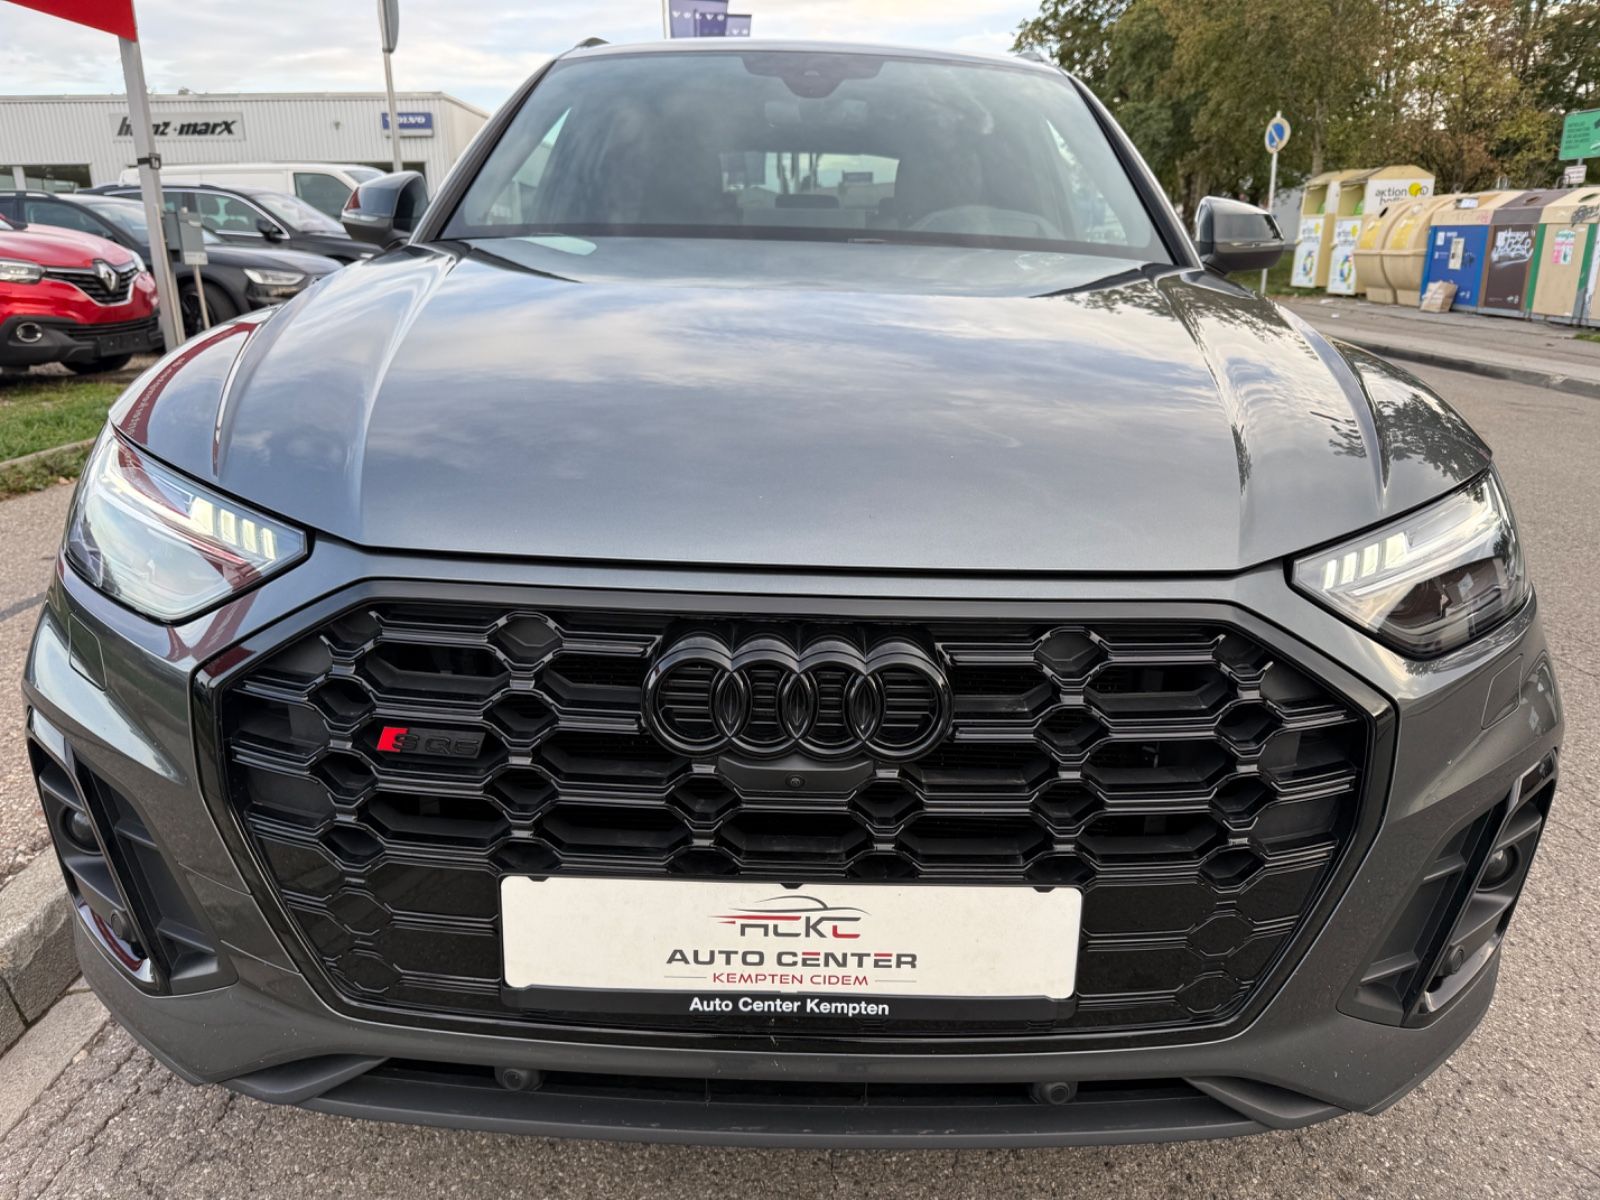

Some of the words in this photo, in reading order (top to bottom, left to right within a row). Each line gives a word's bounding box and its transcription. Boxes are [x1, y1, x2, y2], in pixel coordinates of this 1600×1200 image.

[177, 120, 237, 136] marx
[1375, 186, 1407, 197] aktion
[388, 731, 480, 756] SQ5
[666, 949, 765, 967] AUTO
[776, 951, 918, 969] CENTER
[713, 972, 803, 985] KEMPTEN
[810, 974, 868, 986] CIDEM
[689, 997, 733, 1012] Auto
[738, 997, 801, 1013] Center
[806, 998, 890, 1017] Kempten
